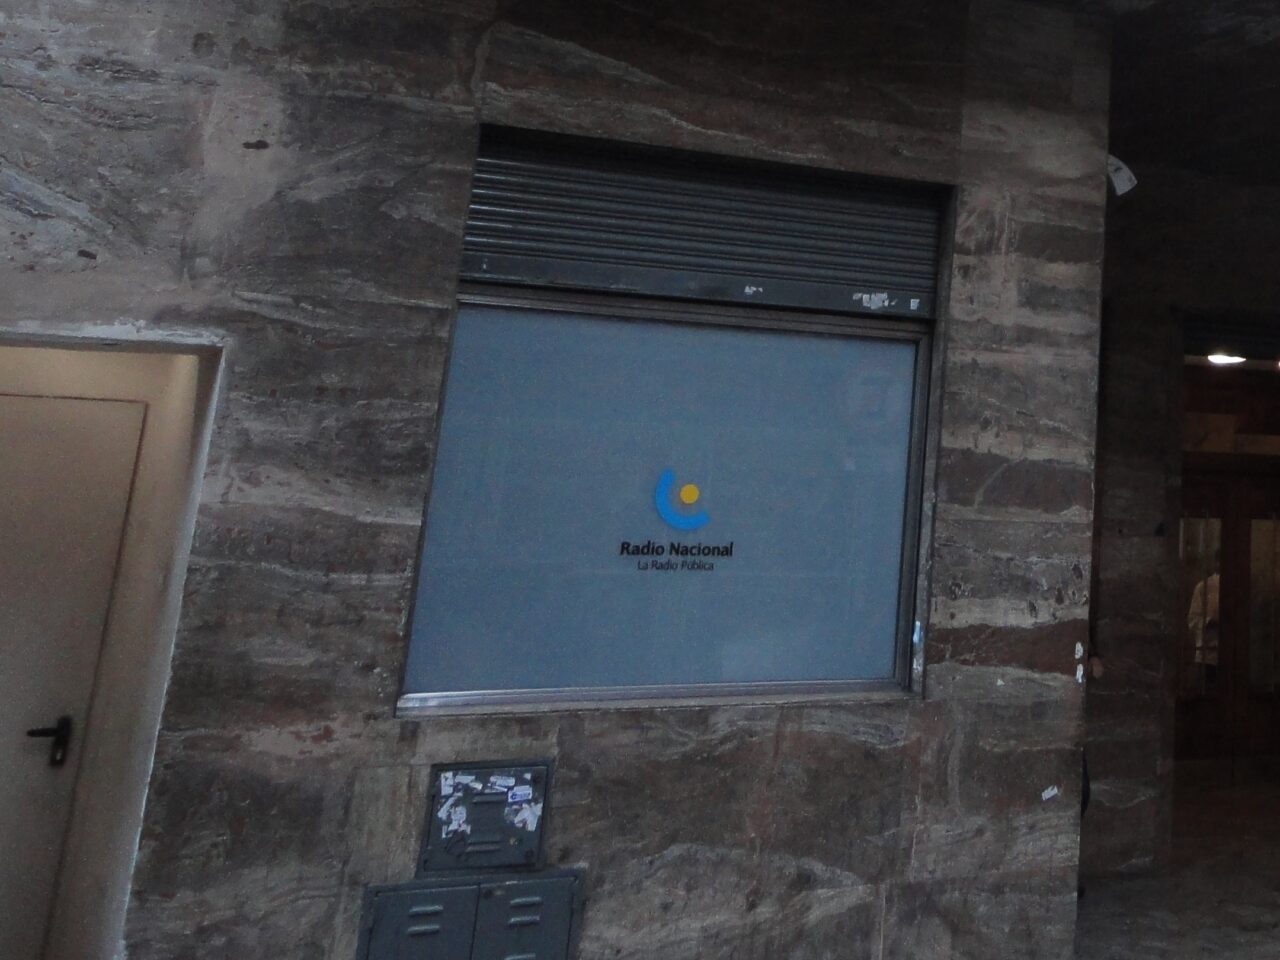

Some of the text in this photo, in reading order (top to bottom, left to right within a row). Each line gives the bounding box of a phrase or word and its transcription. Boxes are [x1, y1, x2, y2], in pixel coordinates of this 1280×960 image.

[620, 540, 734, 557] Radio Nacional
[637, 560, 649, 570] La
[651, 559, 679, 571] Radio
